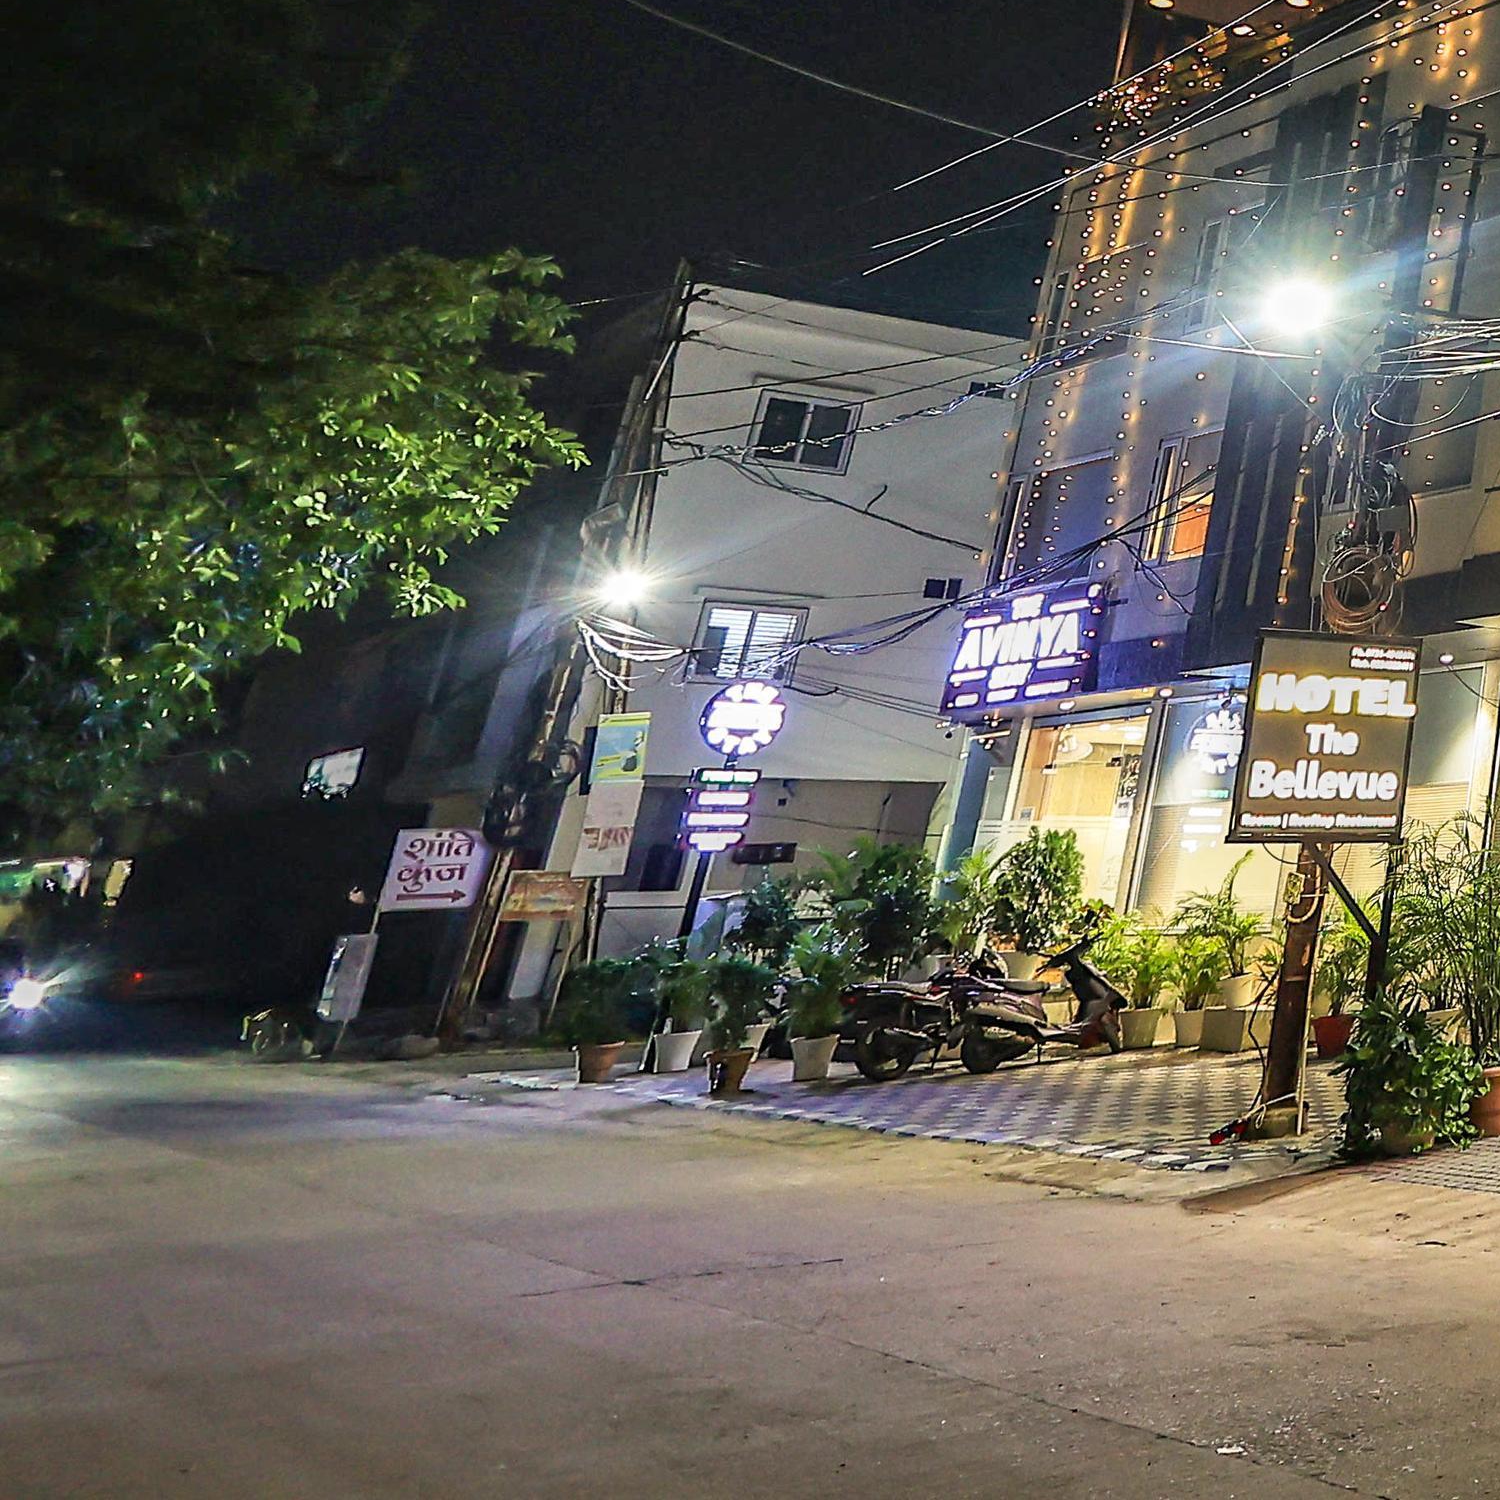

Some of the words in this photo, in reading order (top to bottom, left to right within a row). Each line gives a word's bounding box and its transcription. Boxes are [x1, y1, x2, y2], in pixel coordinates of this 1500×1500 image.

[953, 612, 1079, 671] AVINYA
[1257, 673, 1417, 717] HOTEL
[1305, 722, 1360, 756] The
[1248, 760, 1399, 801] Bellevue
[403, 830, 475, 860] शांति
[397, 858, 469, 893] कुंज
